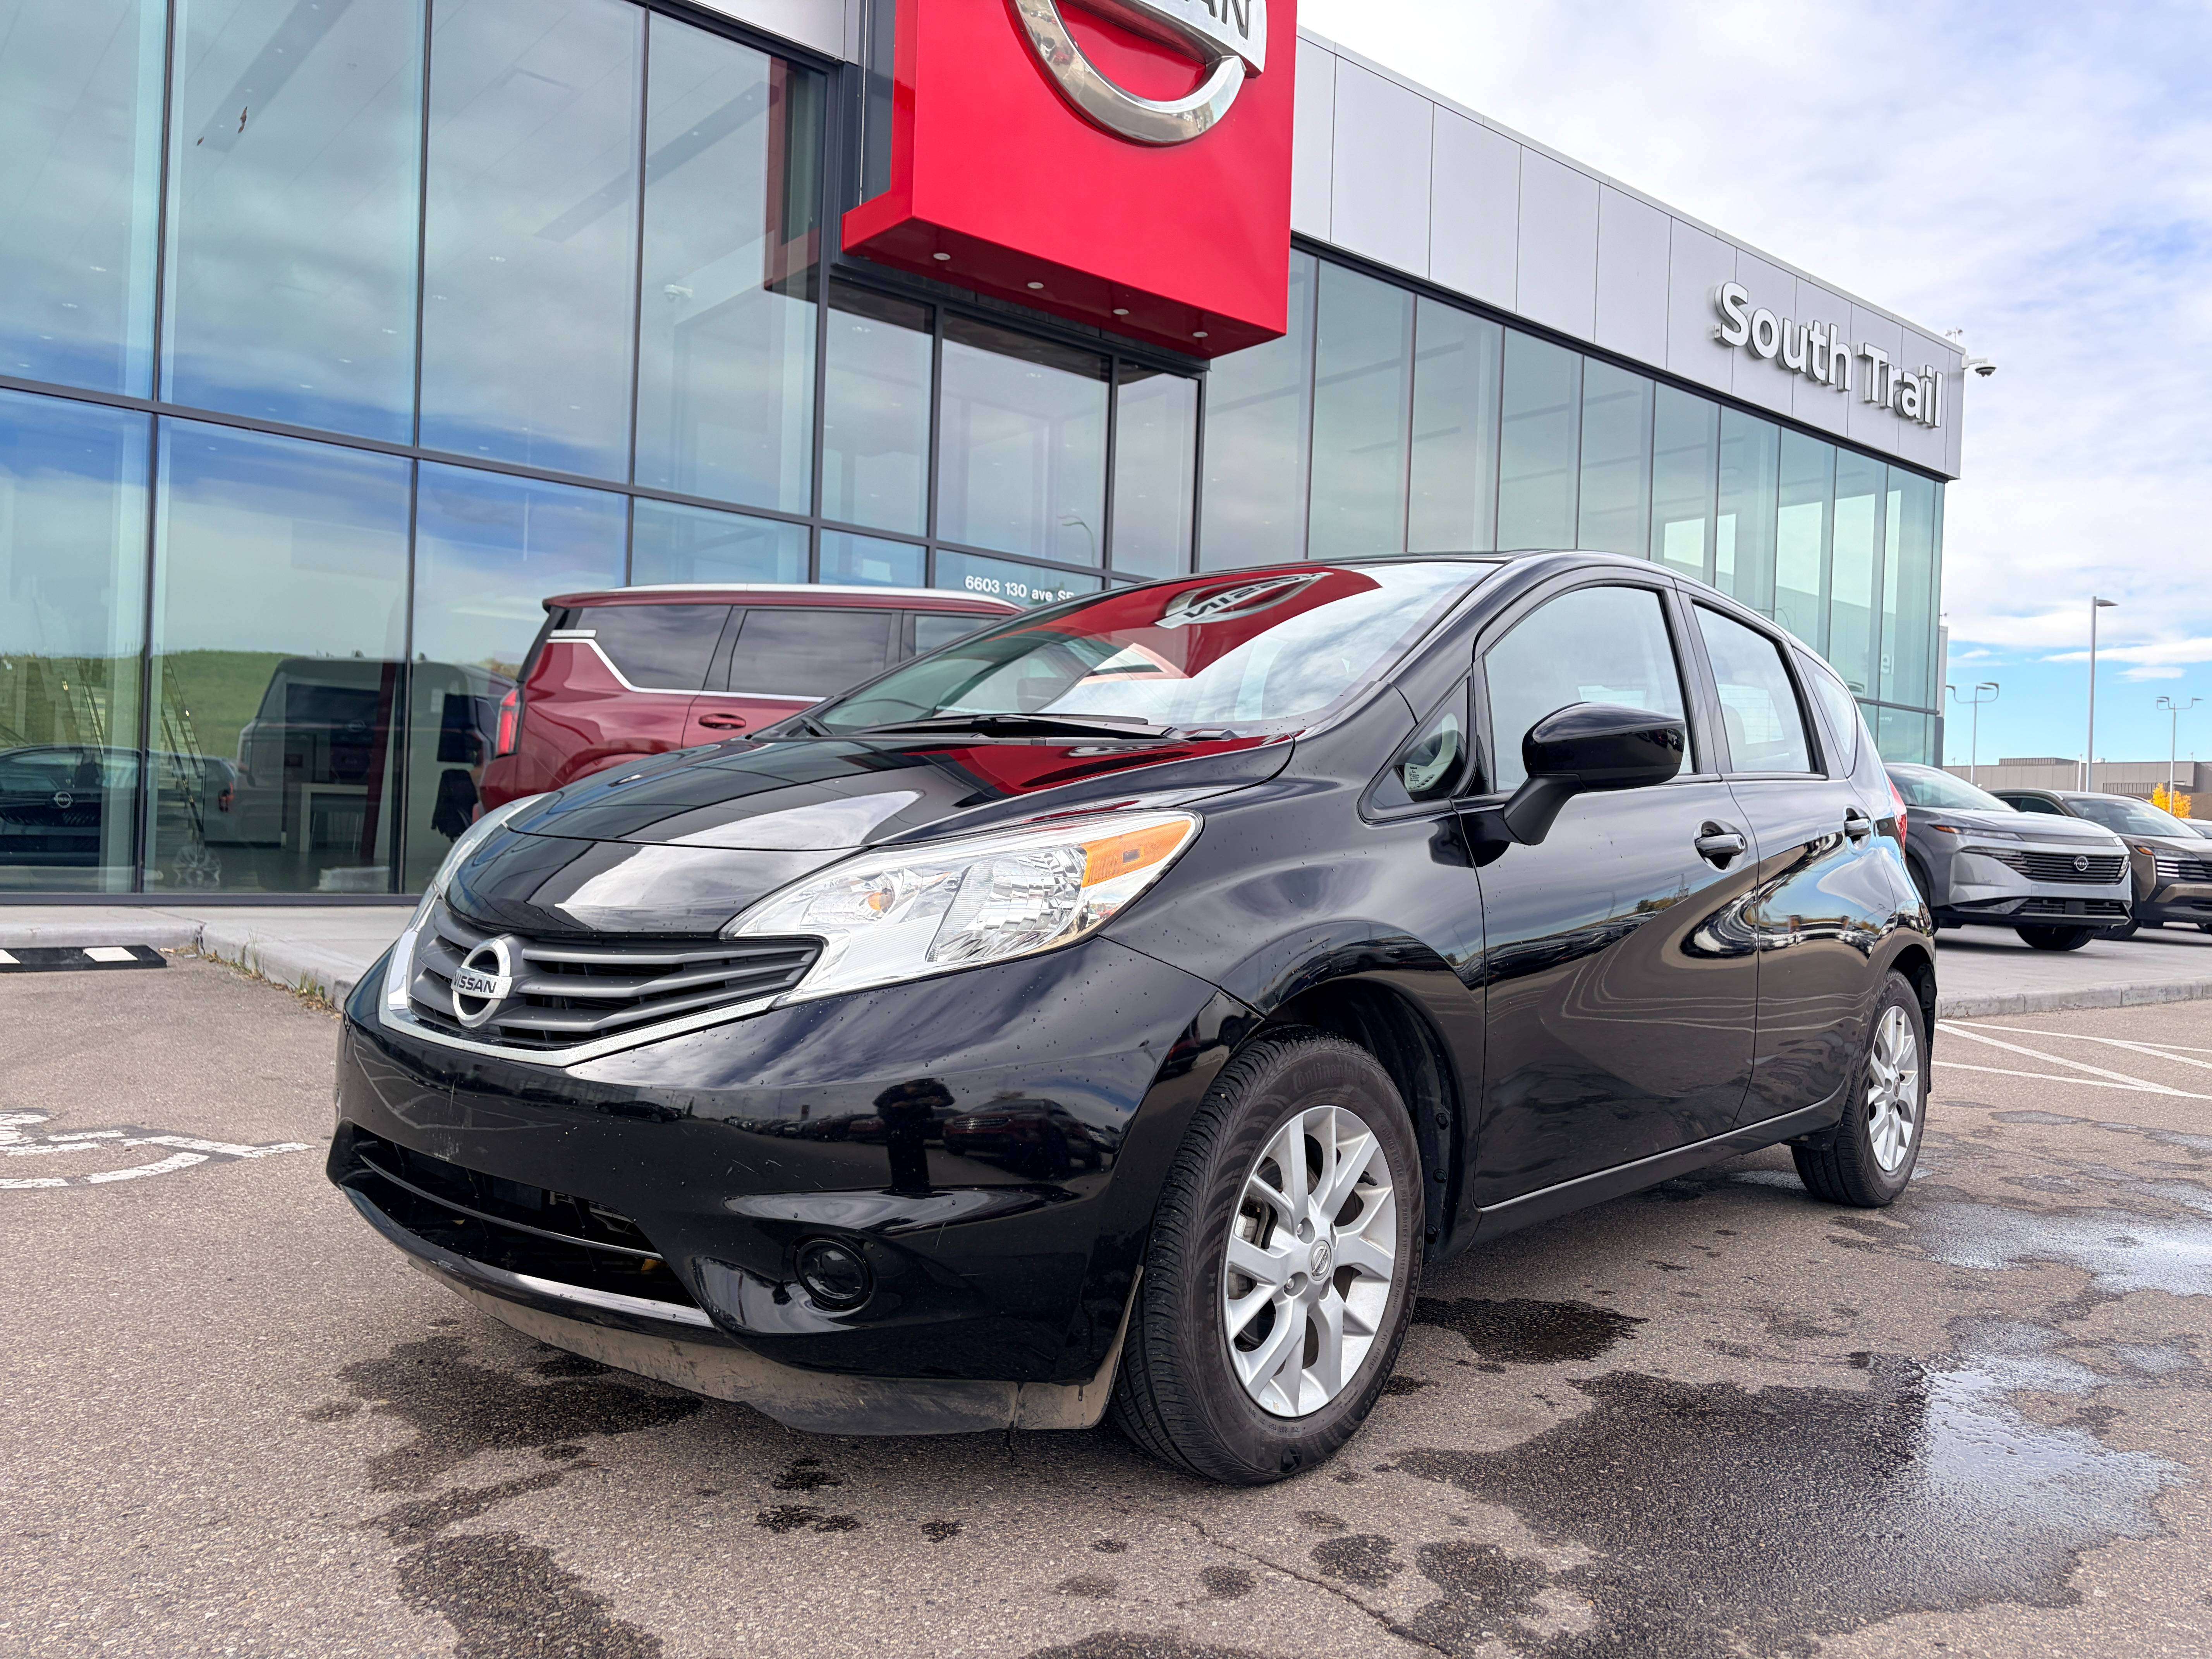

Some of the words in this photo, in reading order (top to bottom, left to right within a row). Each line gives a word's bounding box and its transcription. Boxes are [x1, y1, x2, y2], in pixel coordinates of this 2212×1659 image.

[1714, 281, 1852, 391] South
[1857, 342, 1943, 428] Trail
[965, 575, 1000, 594] 6603
[1005, 582, 1027, 598] 130
[1031, 589, 1053, 602] ave
[454, 972, 497, 994] NISSAN
